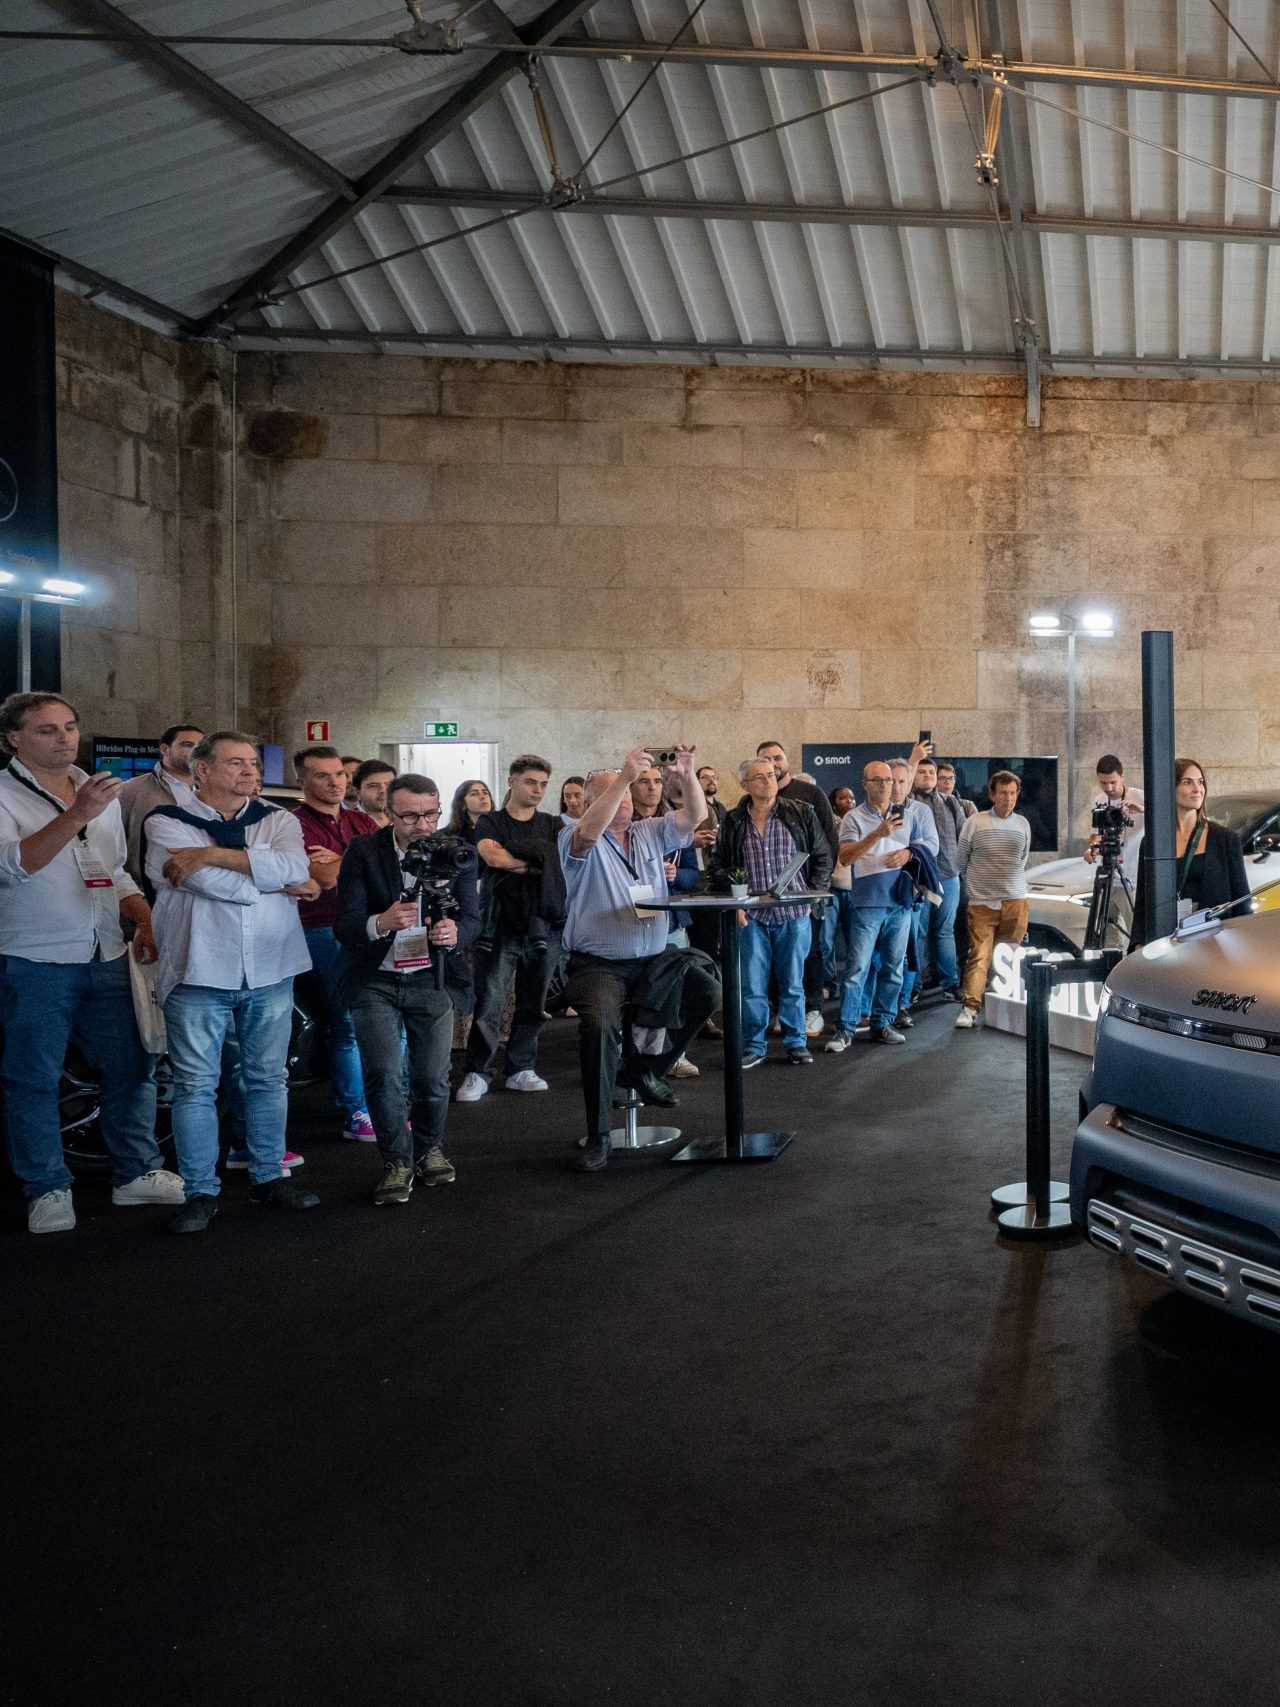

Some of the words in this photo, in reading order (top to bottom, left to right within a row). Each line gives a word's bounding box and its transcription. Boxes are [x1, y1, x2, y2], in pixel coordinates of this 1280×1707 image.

[124, 745, 146, 754] Plug-in
[825, 755, 851, 764] smart
[1192, 989, 1259, 1014] smart
